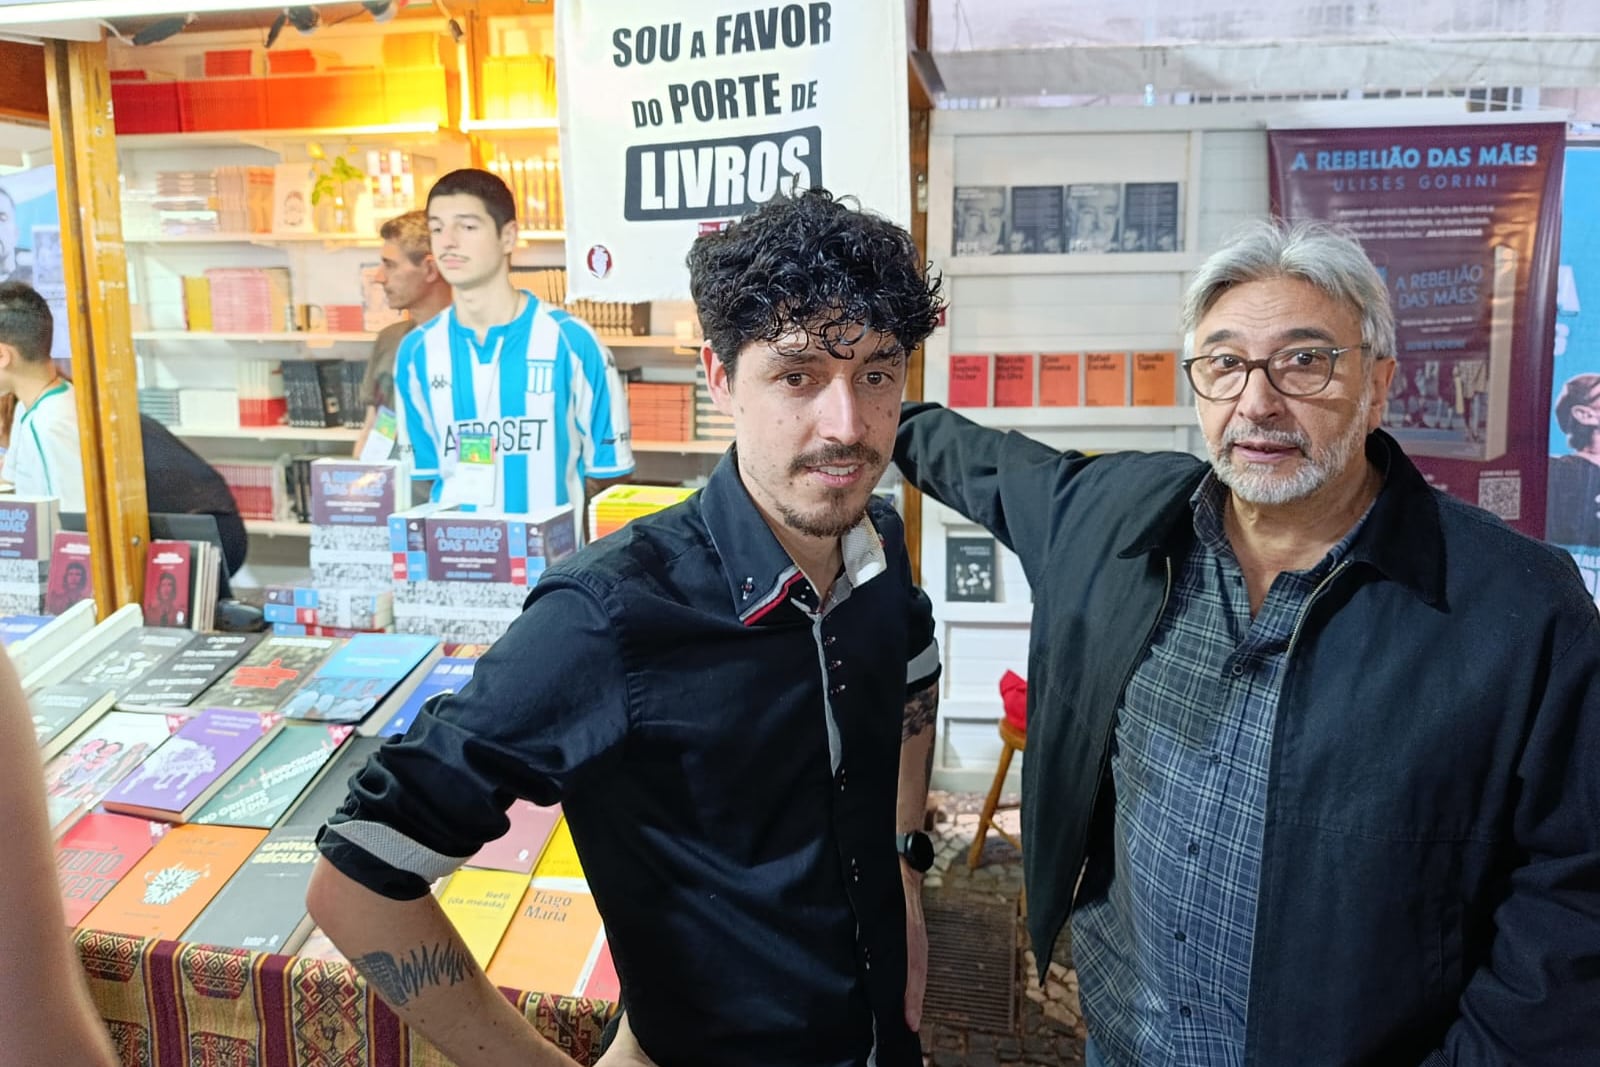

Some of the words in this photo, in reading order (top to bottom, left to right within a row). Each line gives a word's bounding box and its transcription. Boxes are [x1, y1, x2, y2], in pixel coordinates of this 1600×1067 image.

[612, 22, 682, 68] SOU
[690, 30, 706, 59] A
[715, 1, 832, 56] FAVOR
[631, 98, 663, 129] DO
[668, 72, 782, 124] PORTE
[791, 79, 818, 113] DE
[1292, 153, 1308, 171] A
[1317, 145, 1420, 171] REBELIÃO
[1427, 147, 1471, 168] DAS
[1479, 143, 1538, 166] MÃES
[640, 135, 811, 210] LIVROS
[1333, 174, 1405, 192] ULISES
[1419, 173, 1497, 190] GORINI
[1395, 272, 1407, 288] A
[1410, 264, 1483, 288] REBELIÃO
[1398, 292, 1427, 309] DAS
[1432, 286, 1478, 305] MÃES
[435, 527, 445, 538] A
[438, 539, 463, 552] DAS
[532, 891, 572, 907] Tiago
[524, 905, 567, 922] Maria
